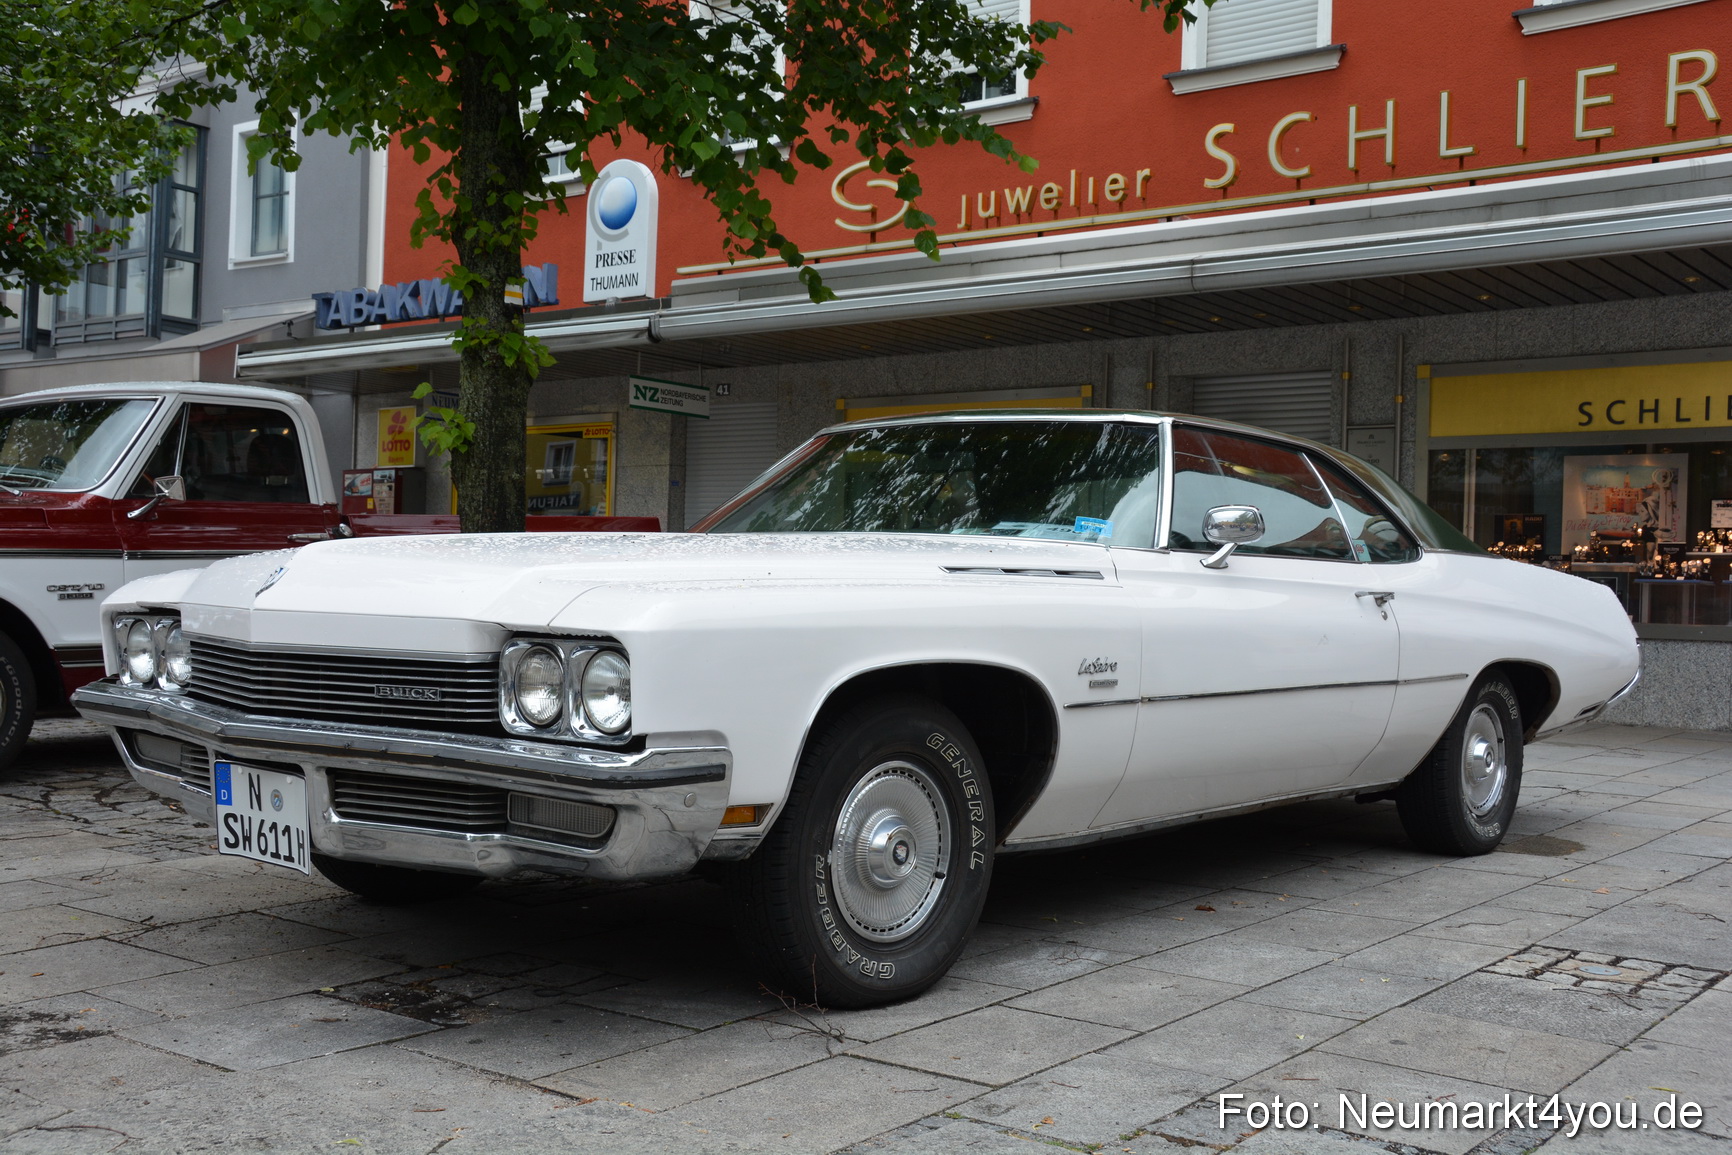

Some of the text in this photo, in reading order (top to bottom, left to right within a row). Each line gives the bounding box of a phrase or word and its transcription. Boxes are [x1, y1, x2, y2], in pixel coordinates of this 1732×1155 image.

[1204, 48, 1721, 189] SCHLIER
[595, 249, 636, 268] PRESSE
[590, 272, 639, 291] THUMANN
[633, 384, 660, 403] NZ
[660, 389, 706, 402] NORDBAYERISCHE
[717, 384, 729, 395] 41
[660, 397, 683, 407] ZEITUNG
[591, 428, 609, 436] LOTTO
[382, 440, 411, 453] LOTTO
[378, 686, 437, 699] BUICK
[221, 789, 228, 800] D
[248, 772, 262, 811] N
[926, 732, 985, 870] GENERAL
[815, 855, 895, 979] GRABBER
